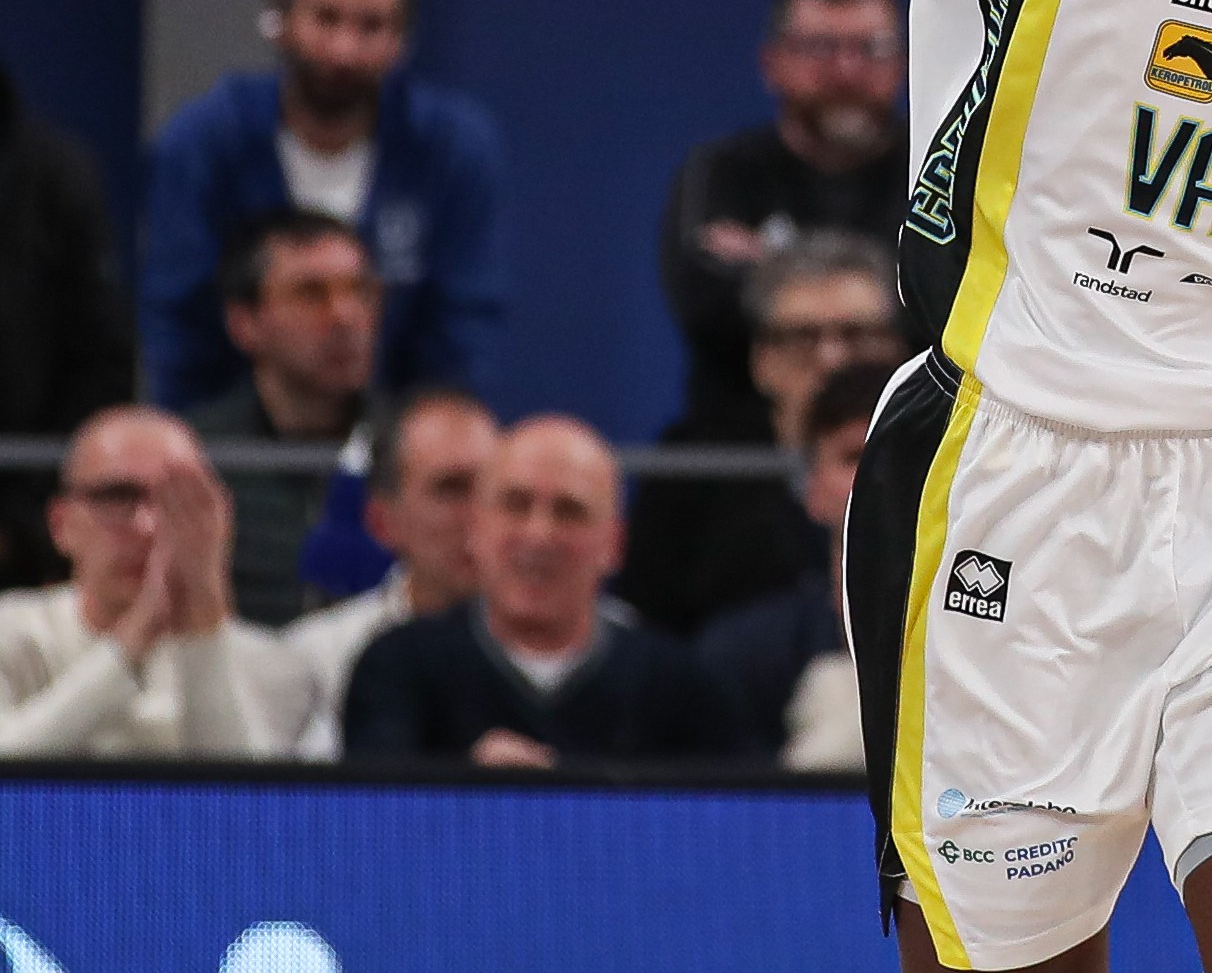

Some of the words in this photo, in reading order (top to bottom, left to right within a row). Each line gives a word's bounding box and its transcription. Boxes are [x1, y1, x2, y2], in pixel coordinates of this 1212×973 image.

[1073, 271, 1152, 303] randstad
[962, 848, 995, 863] BCC
[1006, 850, 1074, 880] PADANO
